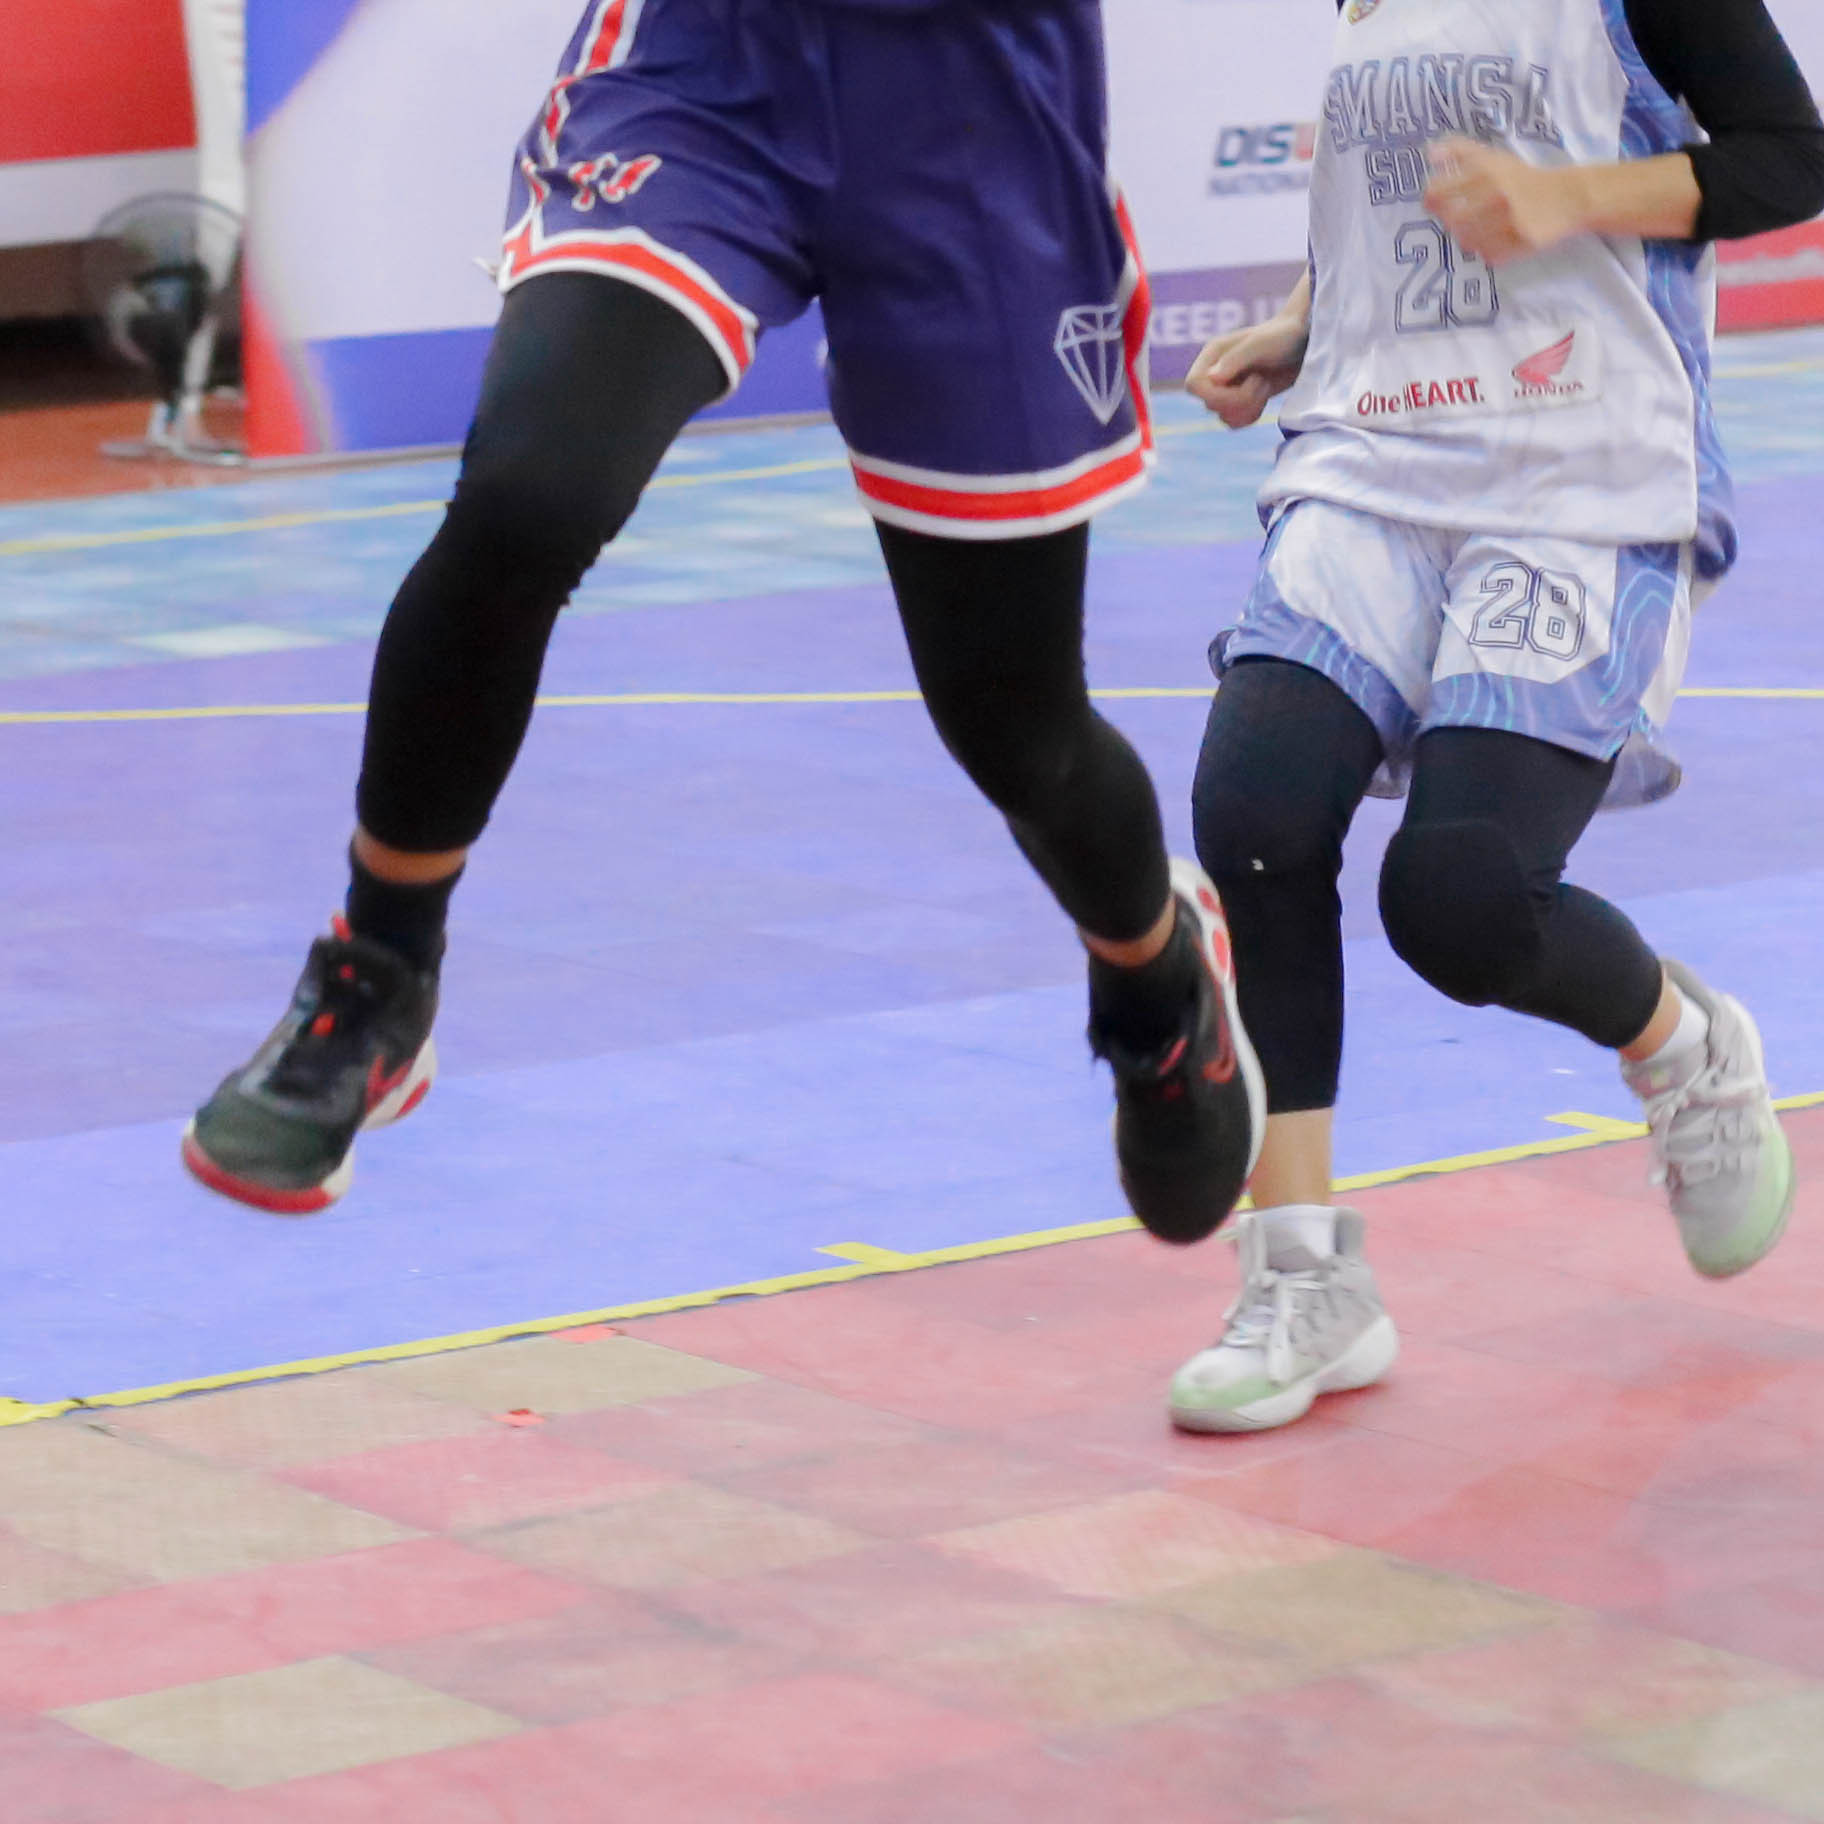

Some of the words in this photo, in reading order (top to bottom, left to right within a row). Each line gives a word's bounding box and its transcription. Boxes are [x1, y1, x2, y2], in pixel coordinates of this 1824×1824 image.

[1324, 51, 1568, 154] SMANSA
[1356, 390, 1402, 417] One
[1467, 560, 1587, 663] 28
